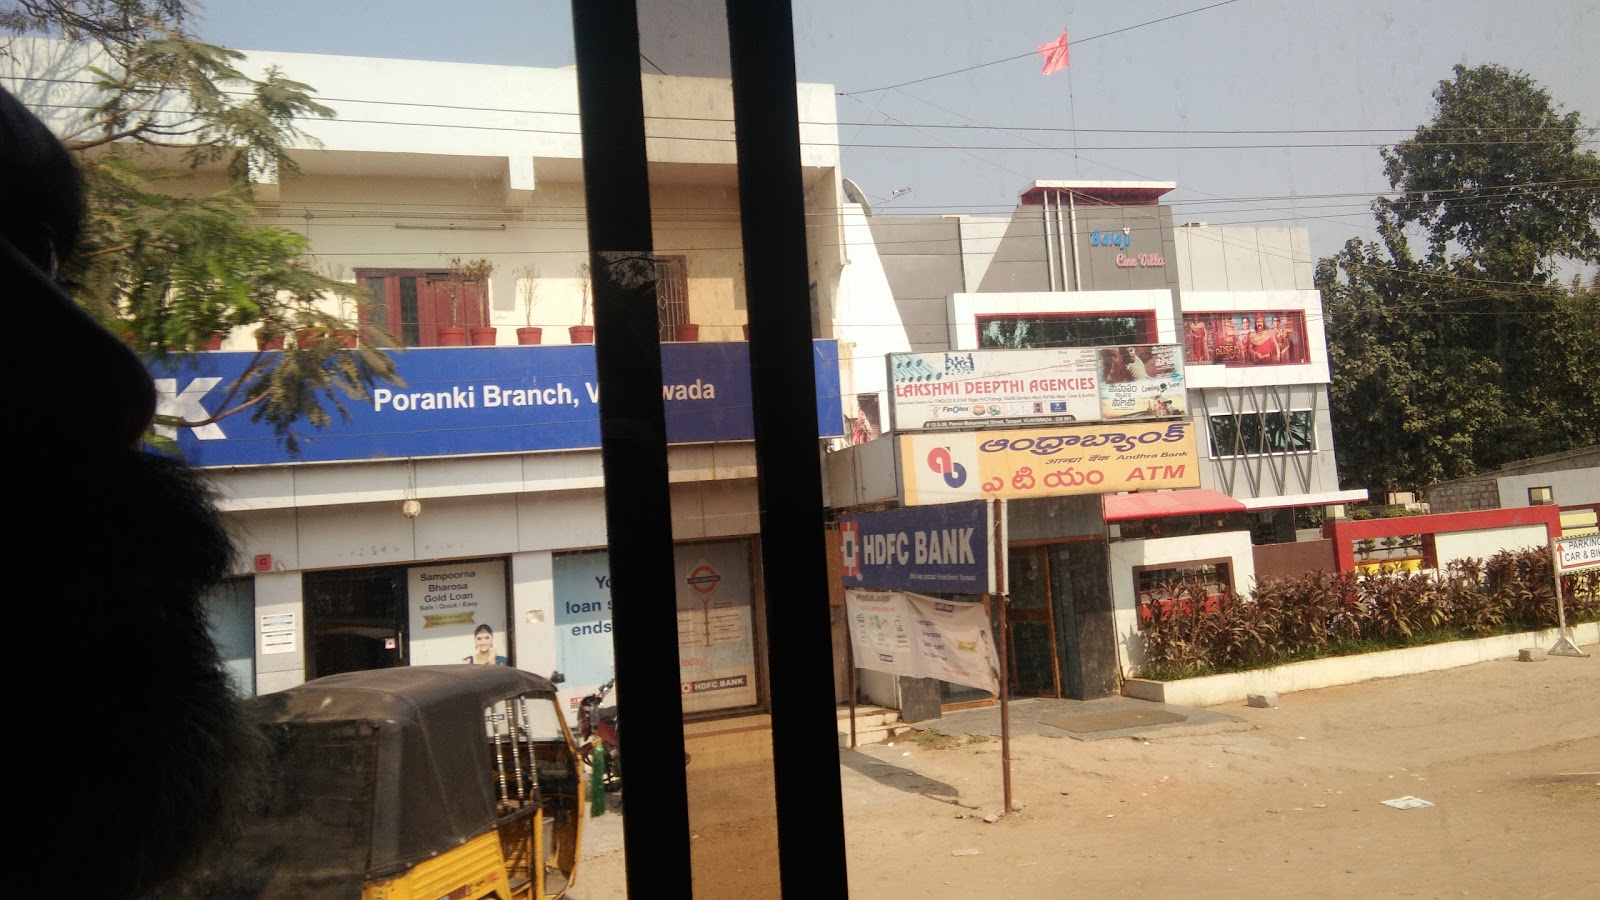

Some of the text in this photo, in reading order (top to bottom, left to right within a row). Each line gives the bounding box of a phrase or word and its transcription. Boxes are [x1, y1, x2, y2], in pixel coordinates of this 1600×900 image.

[1090, 229, 1131, 250] Balaji
[1116, 252, 1165, 268] Cine Villa
[895, 377, 1096, 398] LAKSHMI DEEPTHI AGENCIES
[374, 385, 475, 412] Poranki
[483, 383, 579, 408] Branch,
[1115, 452, 1158, 461] Andhra
[1125, 464, 1186, 482] ATM
[863, 527, 975, 566] HDFC BANK
[1565, 551, 1581, 561] CAR
[1583, 550, 1589, 559] &
[420, 570, 476, 582] Sampoorna
[428, 583, 468, 593] Bharosa
[424, 592, 474, 603] Gold Loan
[566, 601, 602, 614] loan
[571, 621, 612, 636] ends
[694, 677, 744, 691] HDFC BANK
